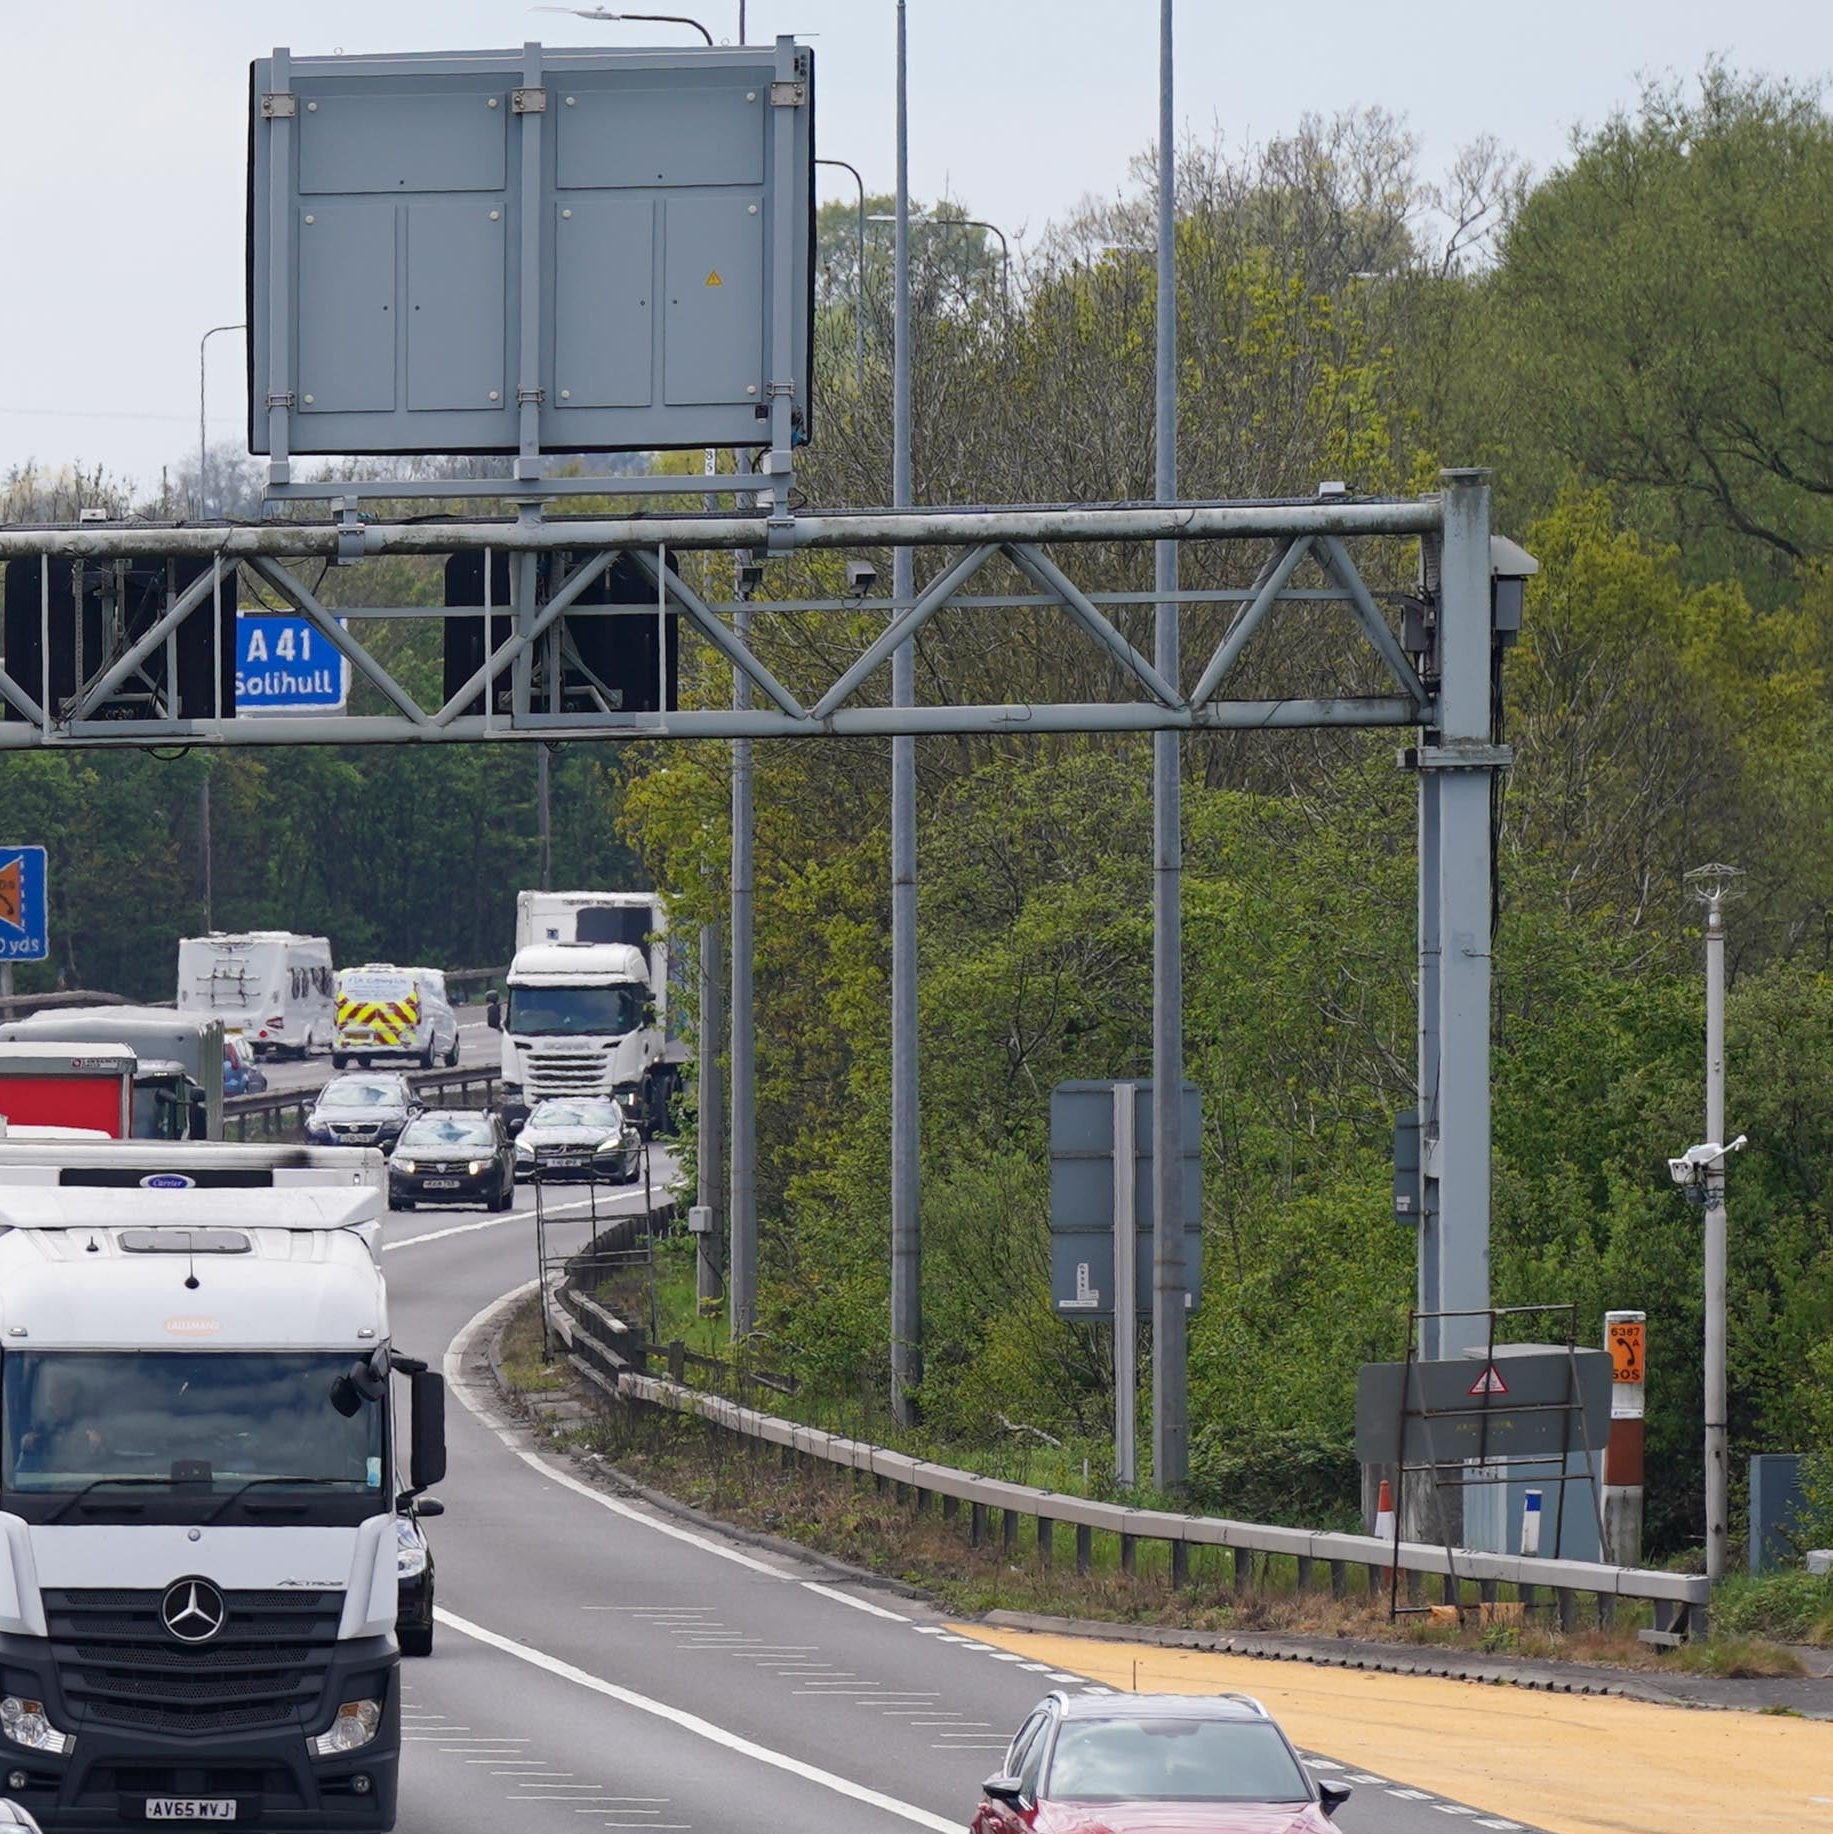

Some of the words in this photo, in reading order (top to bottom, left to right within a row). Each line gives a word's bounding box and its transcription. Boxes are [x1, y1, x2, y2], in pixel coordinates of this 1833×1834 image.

[235, 670, 333, 695] Solihull
[9, 937, 39, 955] yds
[152, 1178, 184, 1187] Carrier
[1611, 1327, 1640, 1337] 6387
[1632, 1339, 1640, 1348] A
[1613, 1369, 1640, 1381] SOS
[153, 1802, 194, 1817] AV65
[199, 1802, 230, 1817] WVJ
